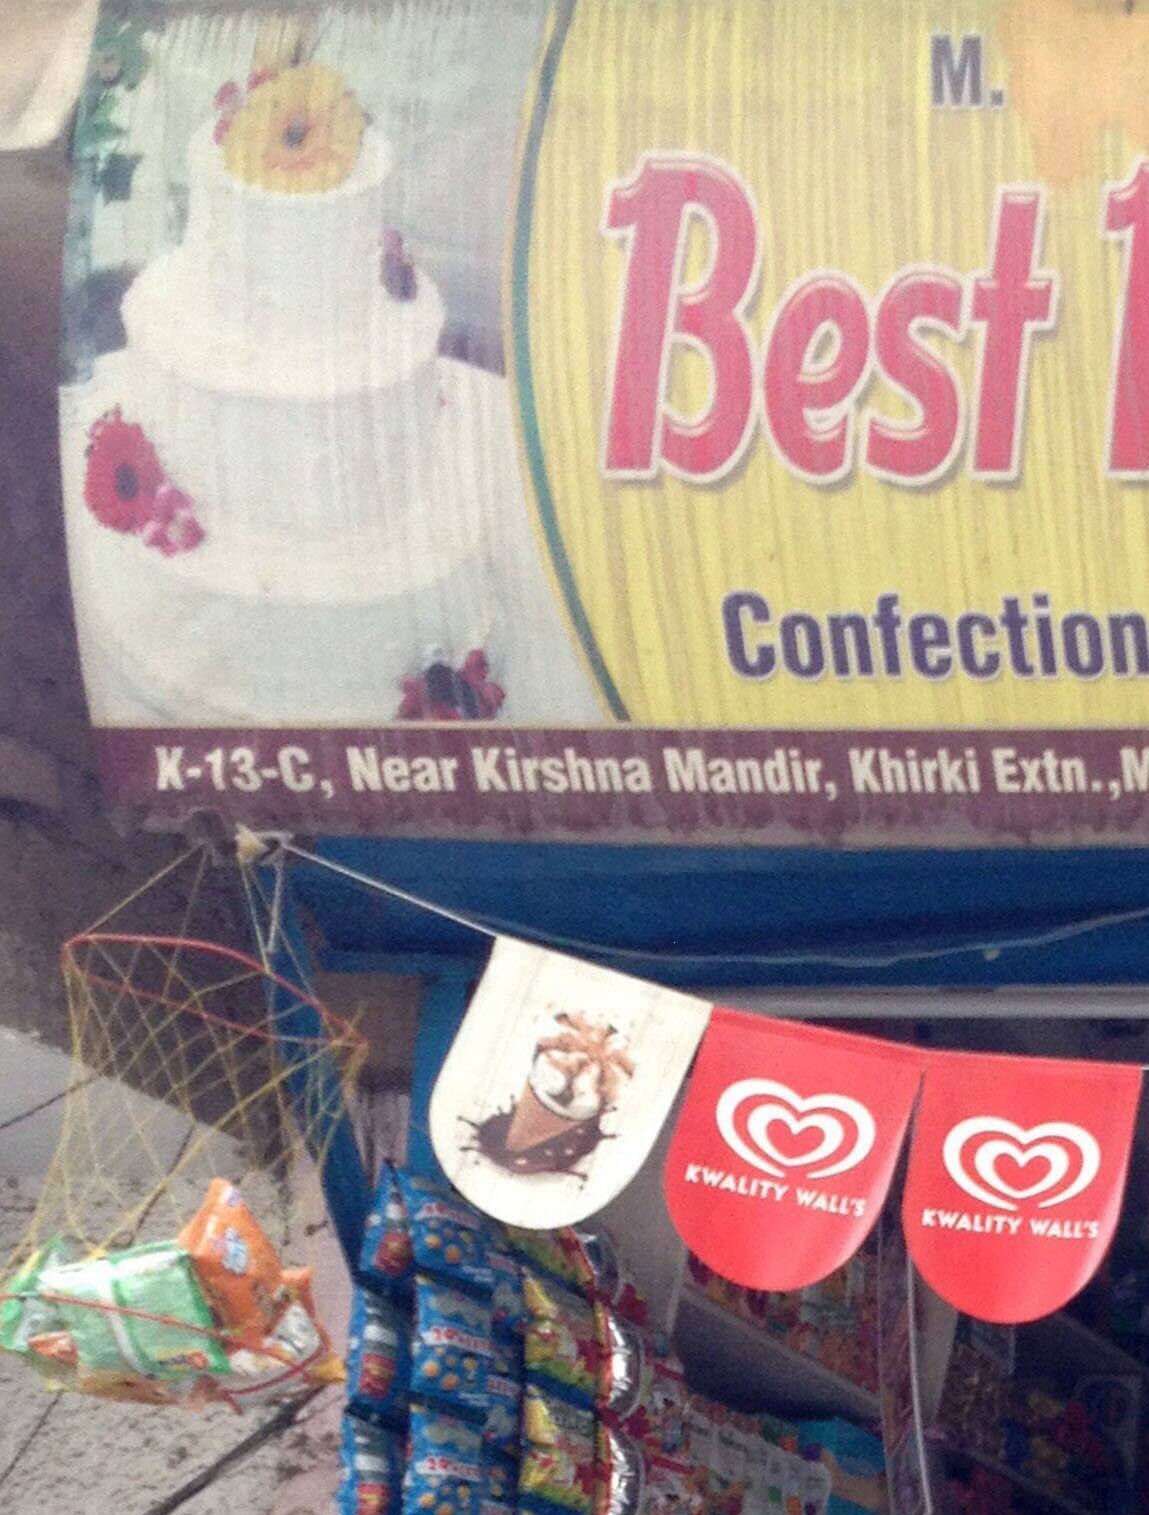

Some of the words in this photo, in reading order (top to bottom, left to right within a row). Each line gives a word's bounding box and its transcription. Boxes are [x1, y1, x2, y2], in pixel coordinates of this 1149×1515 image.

[602, 152, 1058, 485] Best
[154, 745, 335, 799] K-13-C,
[345, 745, 457, 792] Near
[470, 746, 651, 793] Kirshna
[663, 747, 837, 801] Mandir,
[848, 747, 981, 793] Khirki
[683, 1162, 790, 1202] KWALITY
[796, 1186, 867, 1218] WALL'S
[921, 1207, 1023, 1236] KWALITY
[1028, 1218, 1100, 1240] WALL'S
